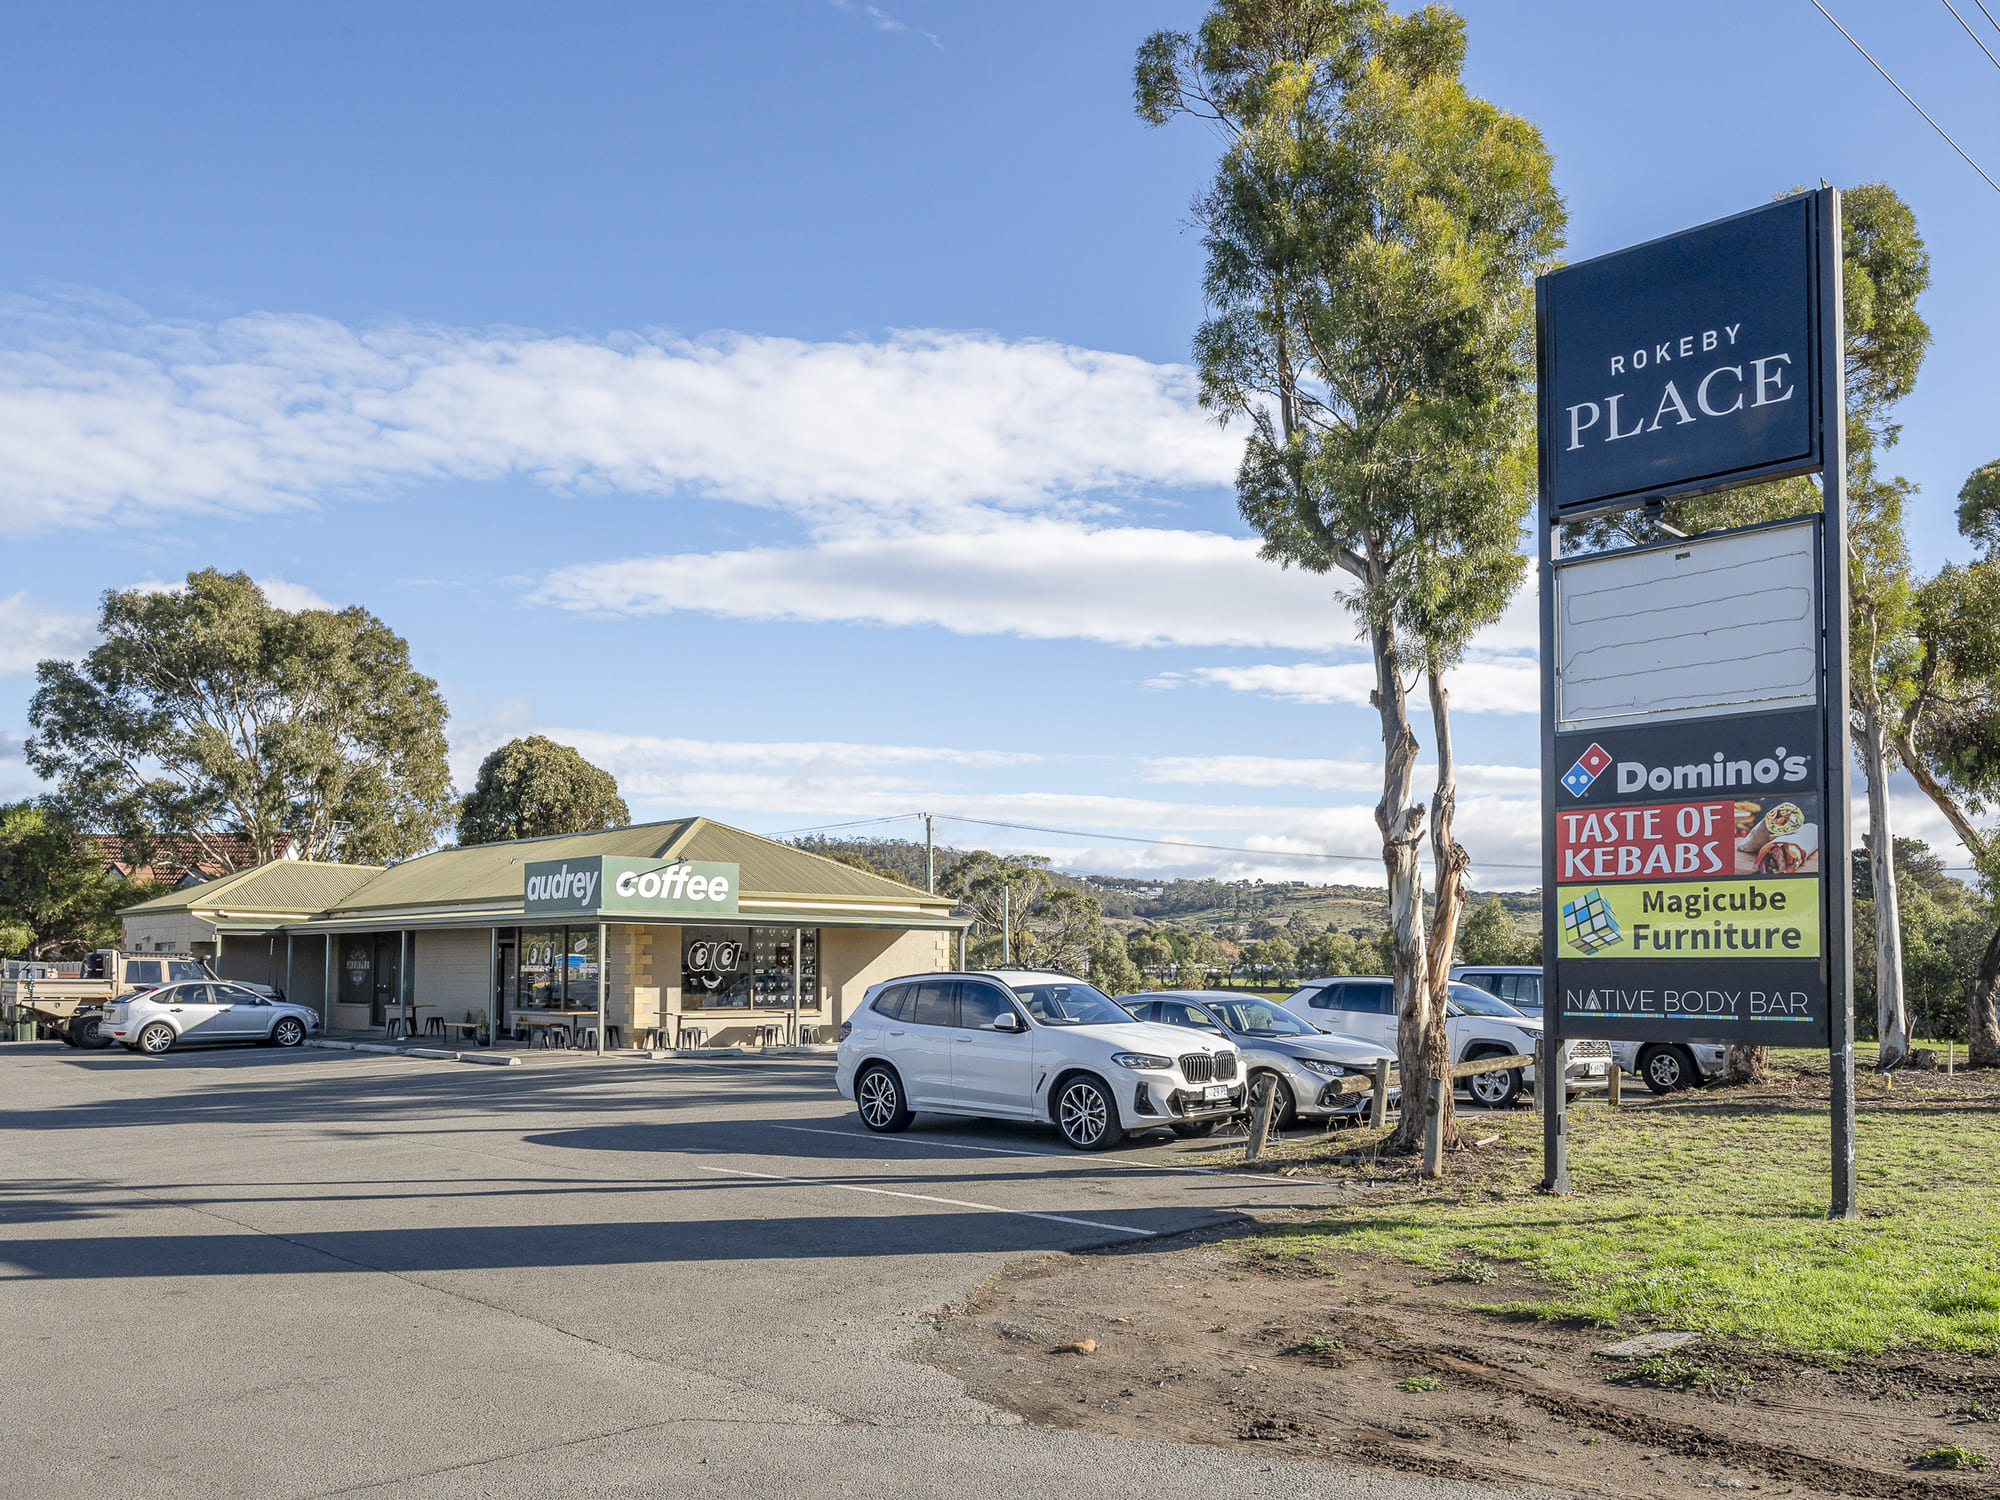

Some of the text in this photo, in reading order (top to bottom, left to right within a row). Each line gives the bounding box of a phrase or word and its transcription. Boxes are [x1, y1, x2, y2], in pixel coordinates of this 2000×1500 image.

[1611, 322, 1741, 376] ROKEBY
[1565, 352, 1794, 452] PLACE
[1616, 746, 1808, 794] Domino's
[1563, 805, 1723, 844] TASTE OF
[1564, 840, 1723, 878] KEBABS
[527, 864, 729, 906] audrey coffee
[1642, 886, 1787, 919] Magicube
[1633, 920, 1802, 951] Furniture
[1567, 989, 1808, 1014] NATIVE BODY BAR
